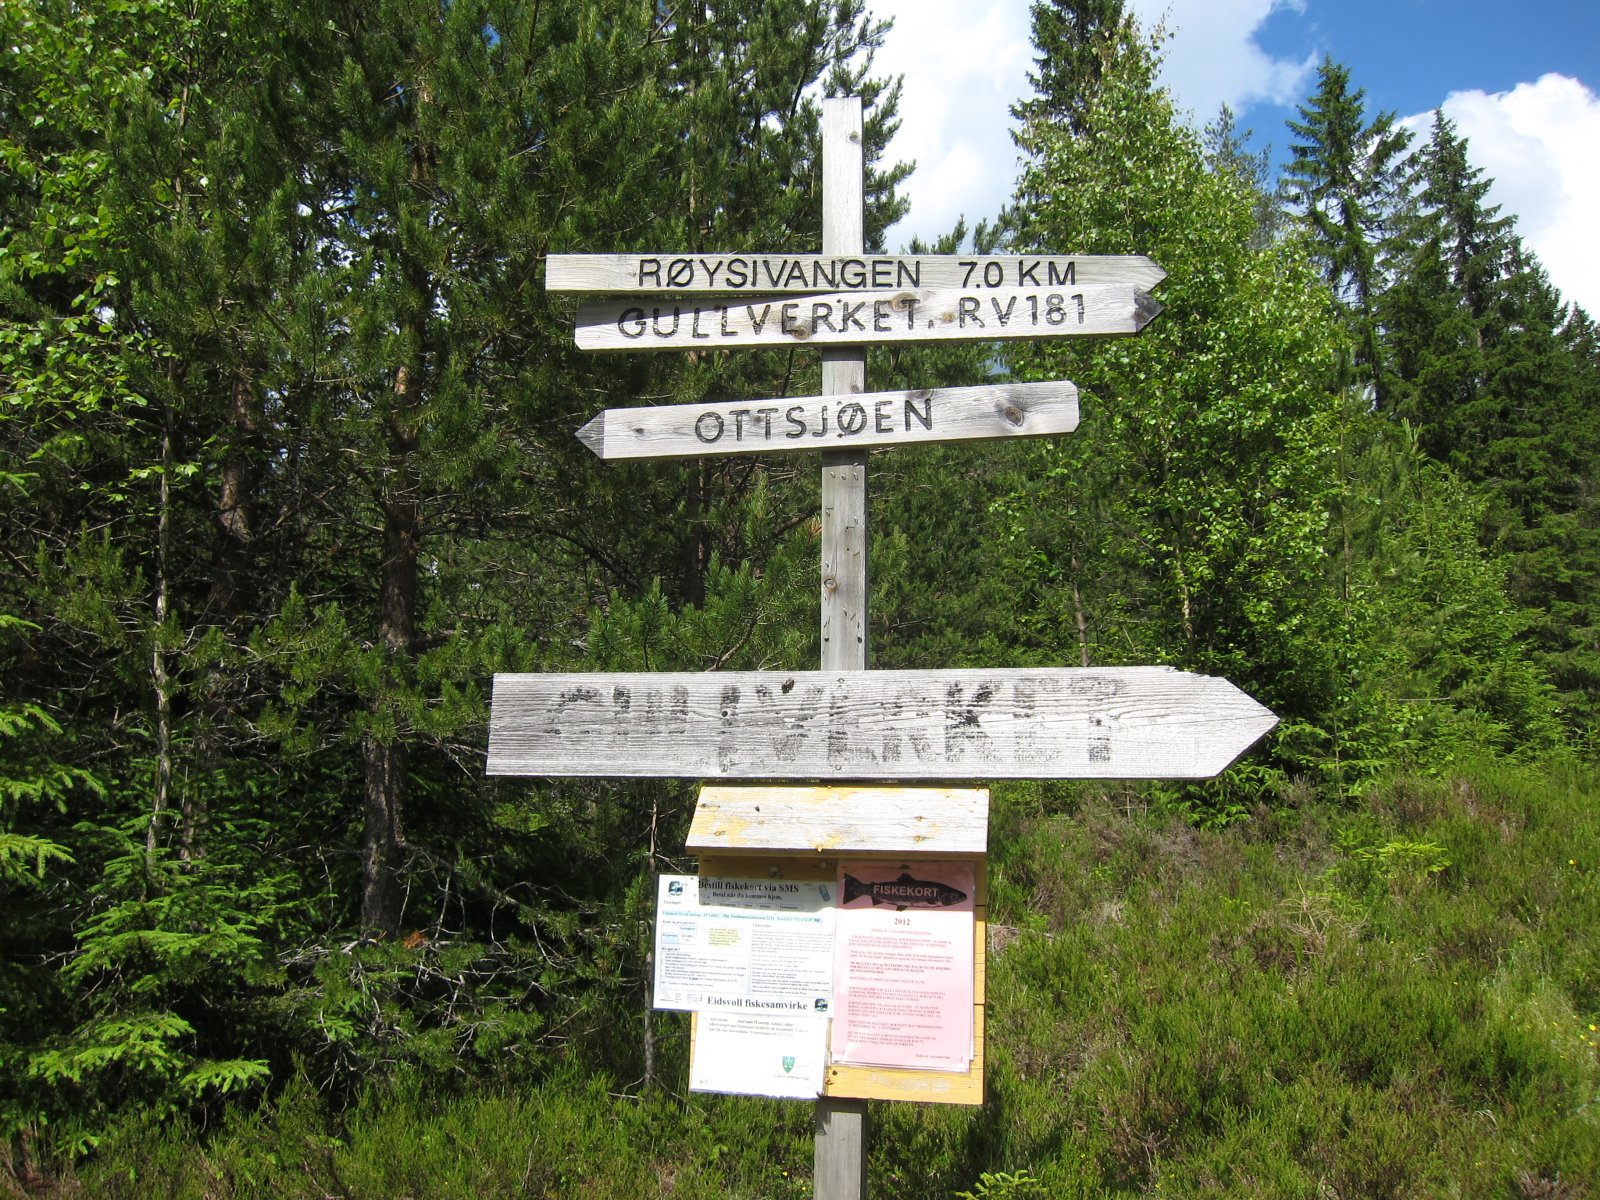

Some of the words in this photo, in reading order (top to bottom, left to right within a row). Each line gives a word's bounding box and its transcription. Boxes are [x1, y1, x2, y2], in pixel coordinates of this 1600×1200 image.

[638, 258, 921, 288] RØYSIVANGEN
[958, 260, 1004, 289] 7.0
[1018, 259, 1076, 287] KM
[694, 398, 933, 443] OTTSJØEN
[698, 880, 723, 890] Bestill
[725, 881, 762, 891] fiskekort
[764, 883, 777, 892] via
[779, 884, 799, 893] SMS
[873, 884, 939, 897] FISKEKORT
[894, 918, 911, 926] 2012
[707, 996, 743, 1007] Eidsvoll
[744, 998, 808, 1010] fiskesamvirke
